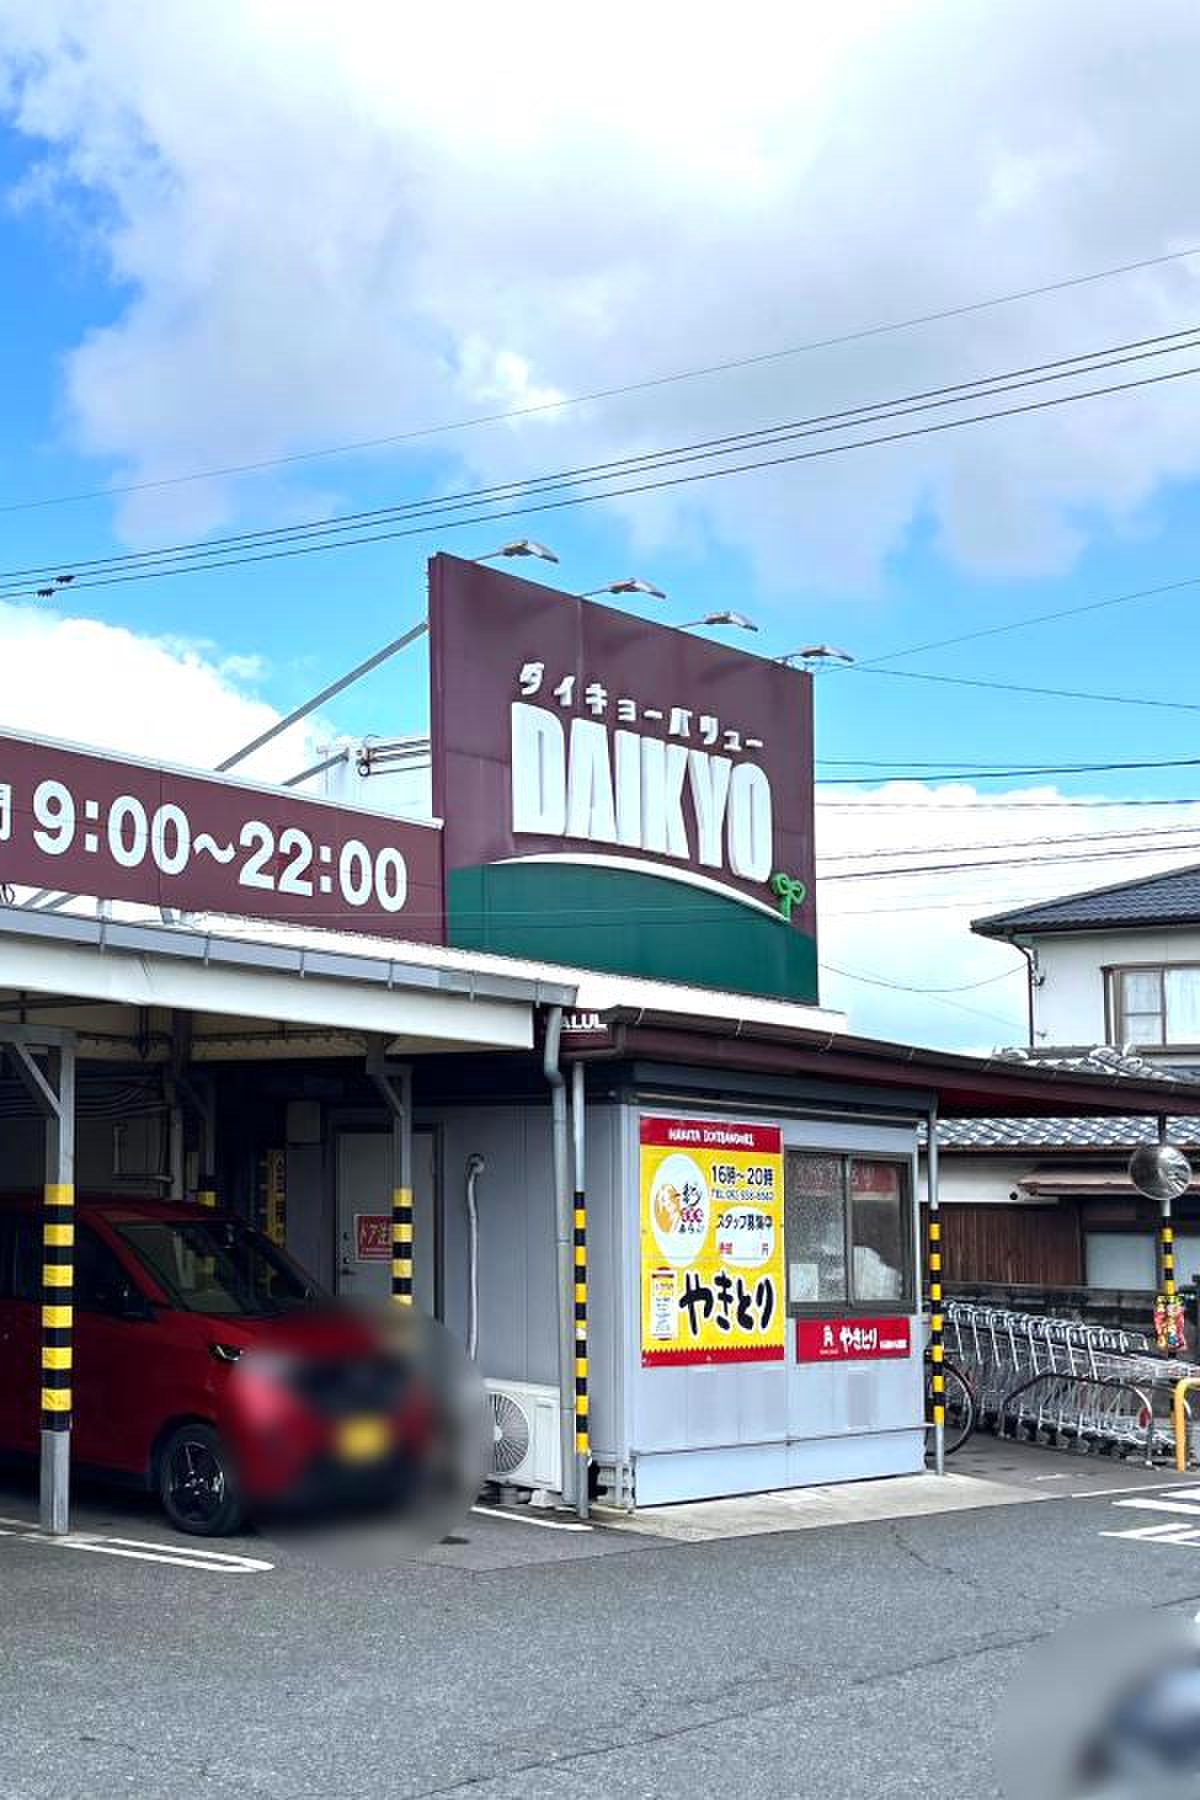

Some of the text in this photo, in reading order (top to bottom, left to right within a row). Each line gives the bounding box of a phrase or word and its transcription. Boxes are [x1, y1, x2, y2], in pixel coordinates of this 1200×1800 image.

[518, 661, 763, 753] ダイキョーバリュー
[511, 701, 772, 884] DAIKYO
[679, 1272, 774, 1335] やきとり
[839, 1325, 878, 1353] やきとり
